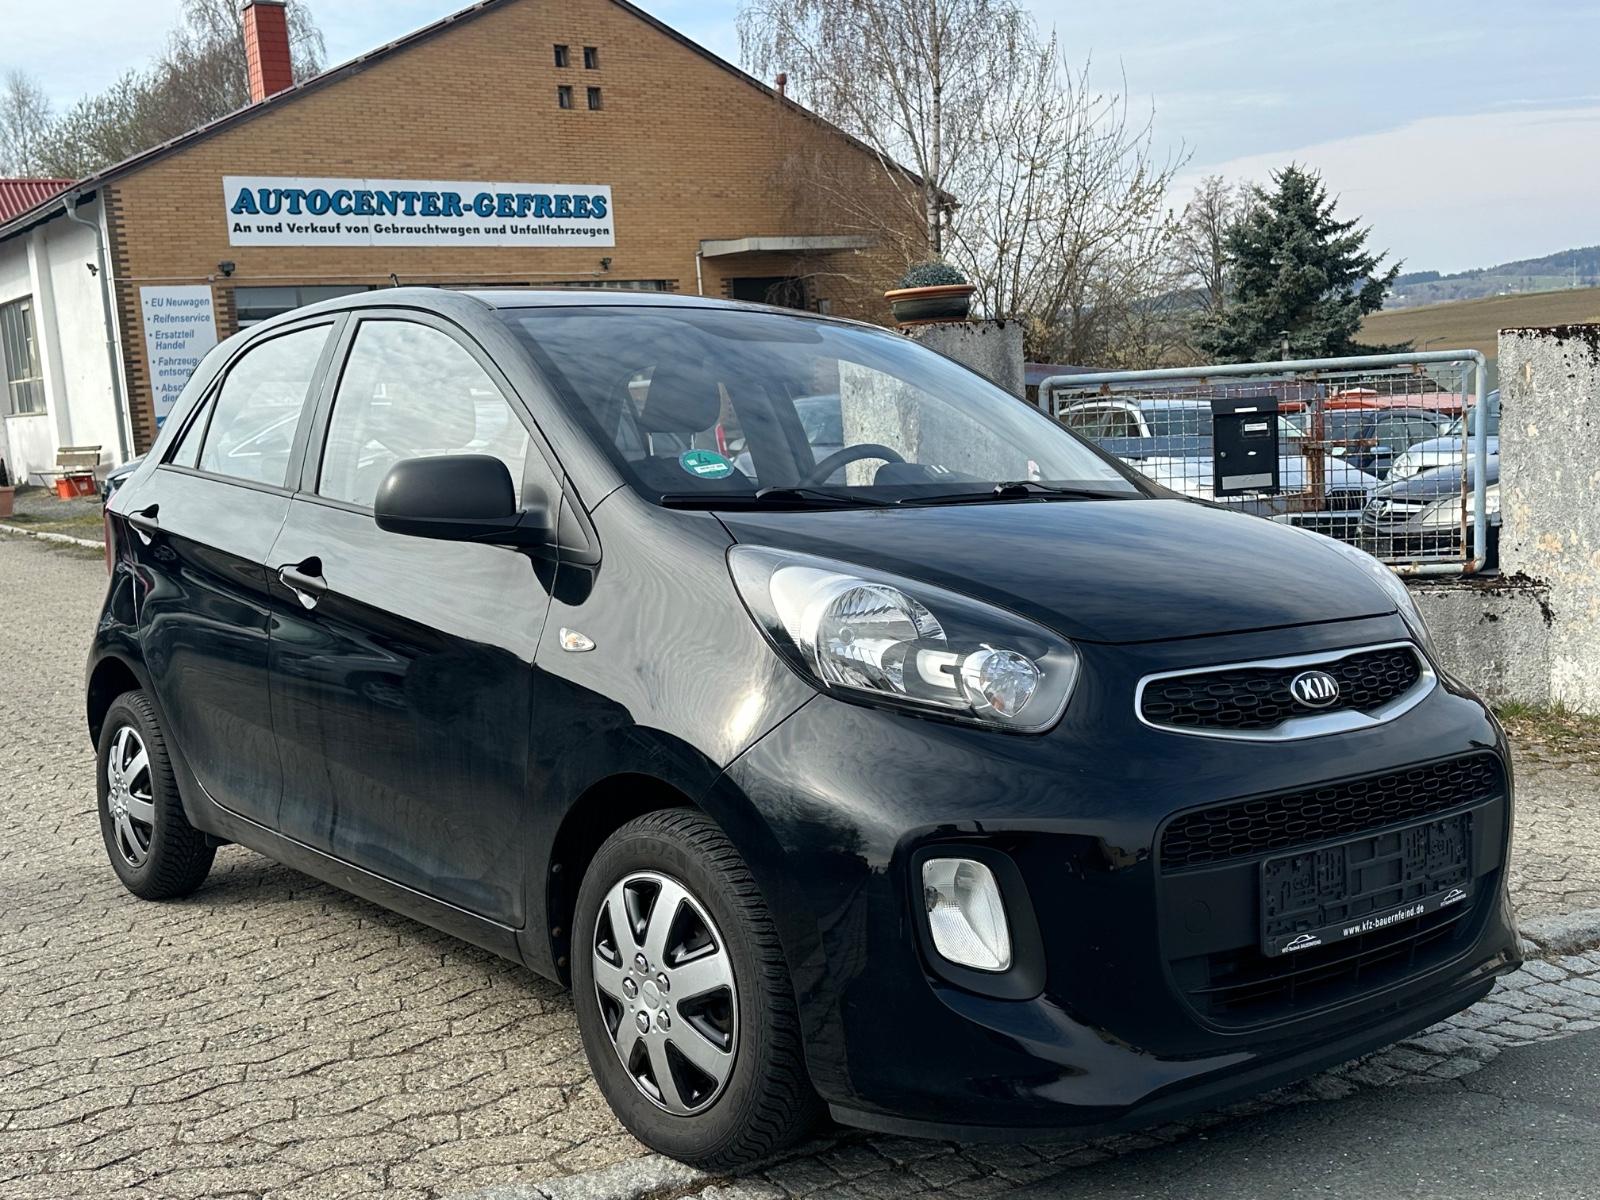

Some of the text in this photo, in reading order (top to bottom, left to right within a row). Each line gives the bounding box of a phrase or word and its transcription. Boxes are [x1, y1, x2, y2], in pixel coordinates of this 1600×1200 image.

[231, 188, 608, 219] AUTOCENTER-GEFREES
[233, 223, 610, 237] An und Verkauf von Gebrauchtwagen und Unfallfahrzeugen
[151, 297, 210, 308] EU Neuwagen
[153, 313, 210, 323] Reifenservice
[155, 330, 194, 339] Ersatzteil
[155, 340, 186, 350] Handel
[1298, 676, 1336, 700] KIA
[1343, 904, 1424, 936] www.kfz-bauernfeind.de
